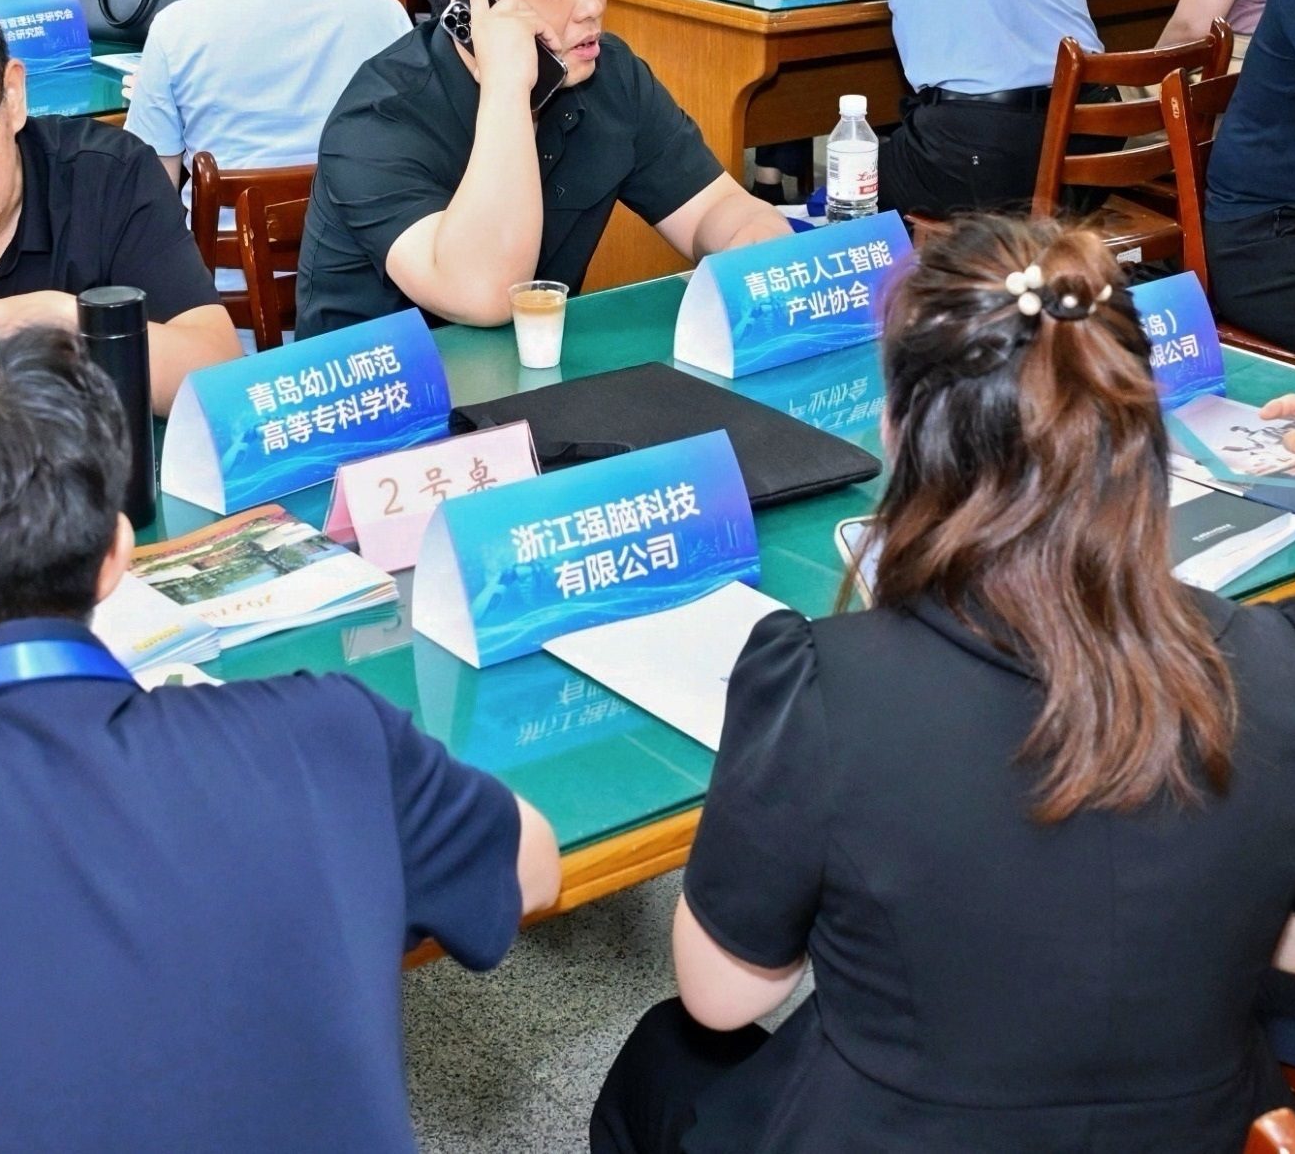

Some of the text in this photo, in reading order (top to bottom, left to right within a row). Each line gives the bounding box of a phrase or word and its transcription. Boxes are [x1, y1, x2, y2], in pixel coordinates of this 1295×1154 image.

[743, 240, 894, 301] 青岛市人工智能
[785, 280, 870, 327] 产业协会
[246, 344, 402, 416] 青岛幼儿师范
[258, 380, 412, 456] 高等专科学校
[509, 481, 701, 564] 浙江强脑科技
[553, 532, 679, 599] 有限公司
